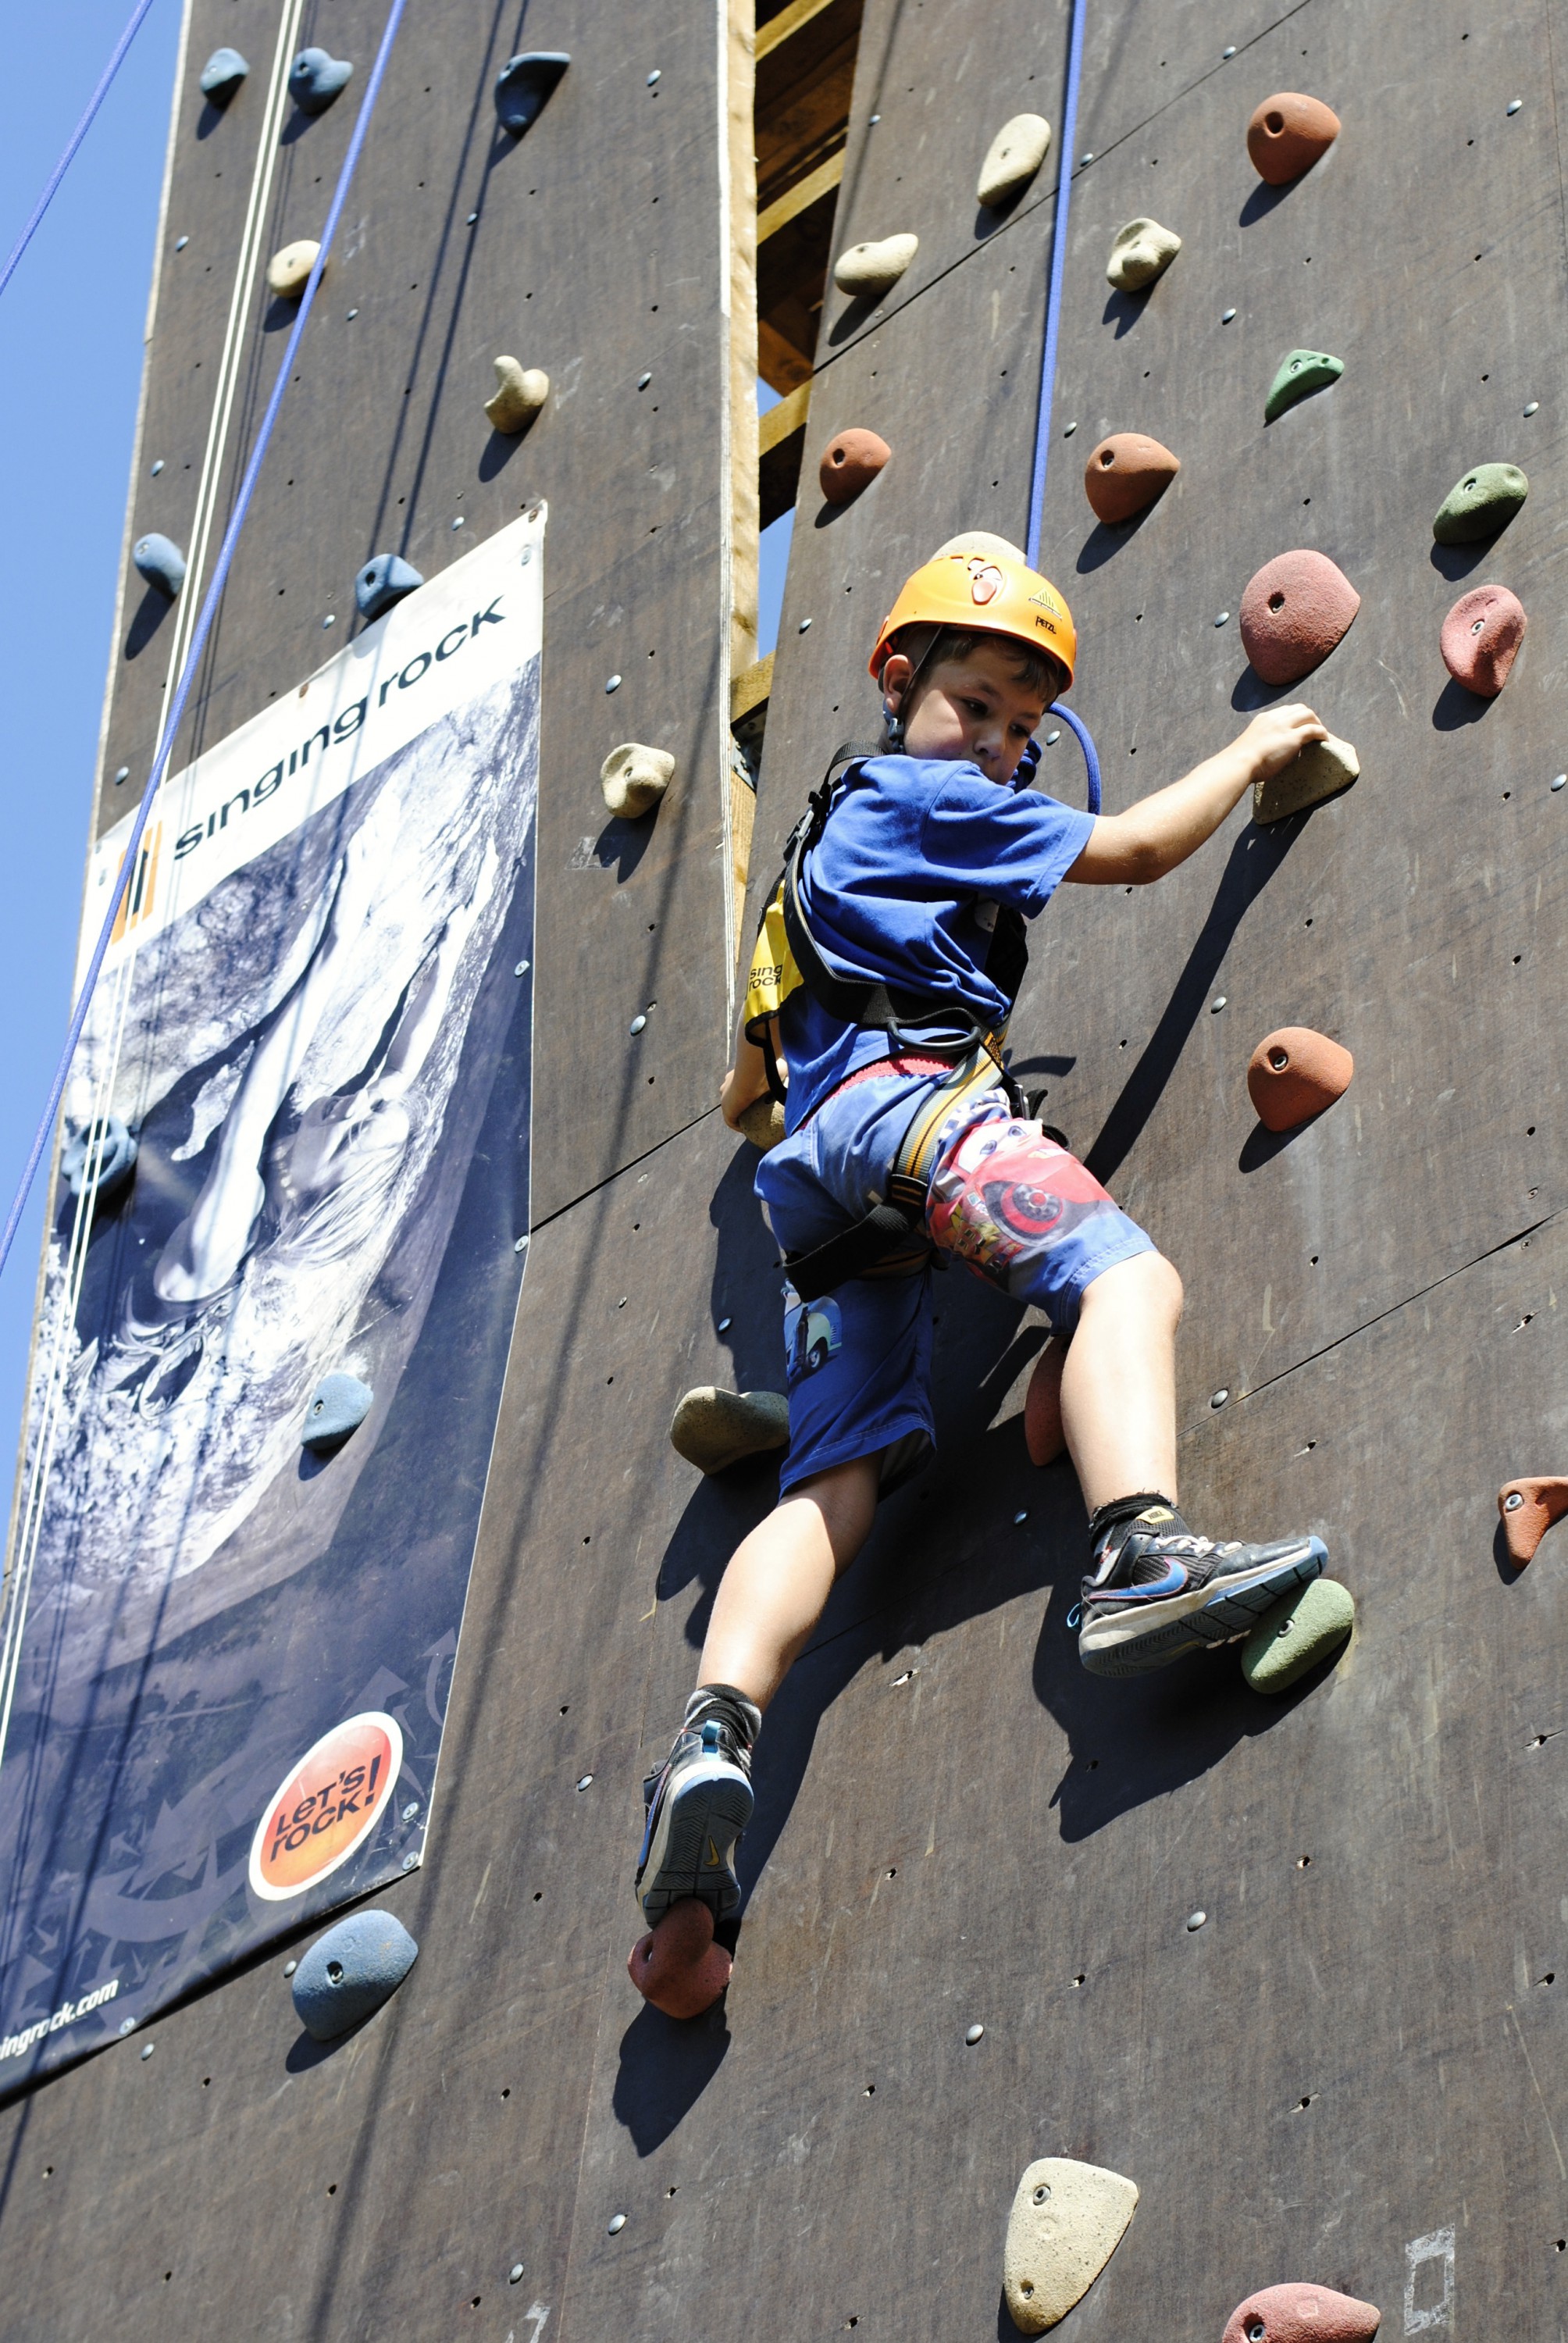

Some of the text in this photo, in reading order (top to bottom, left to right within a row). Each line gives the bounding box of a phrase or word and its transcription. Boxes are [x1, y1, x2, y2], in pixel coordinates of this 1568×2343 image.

[1035, 615, 1057, 634] PETZL
[174, 696, 369, 861] singing
[0, 1979, 119, 2060] ingrock.com
